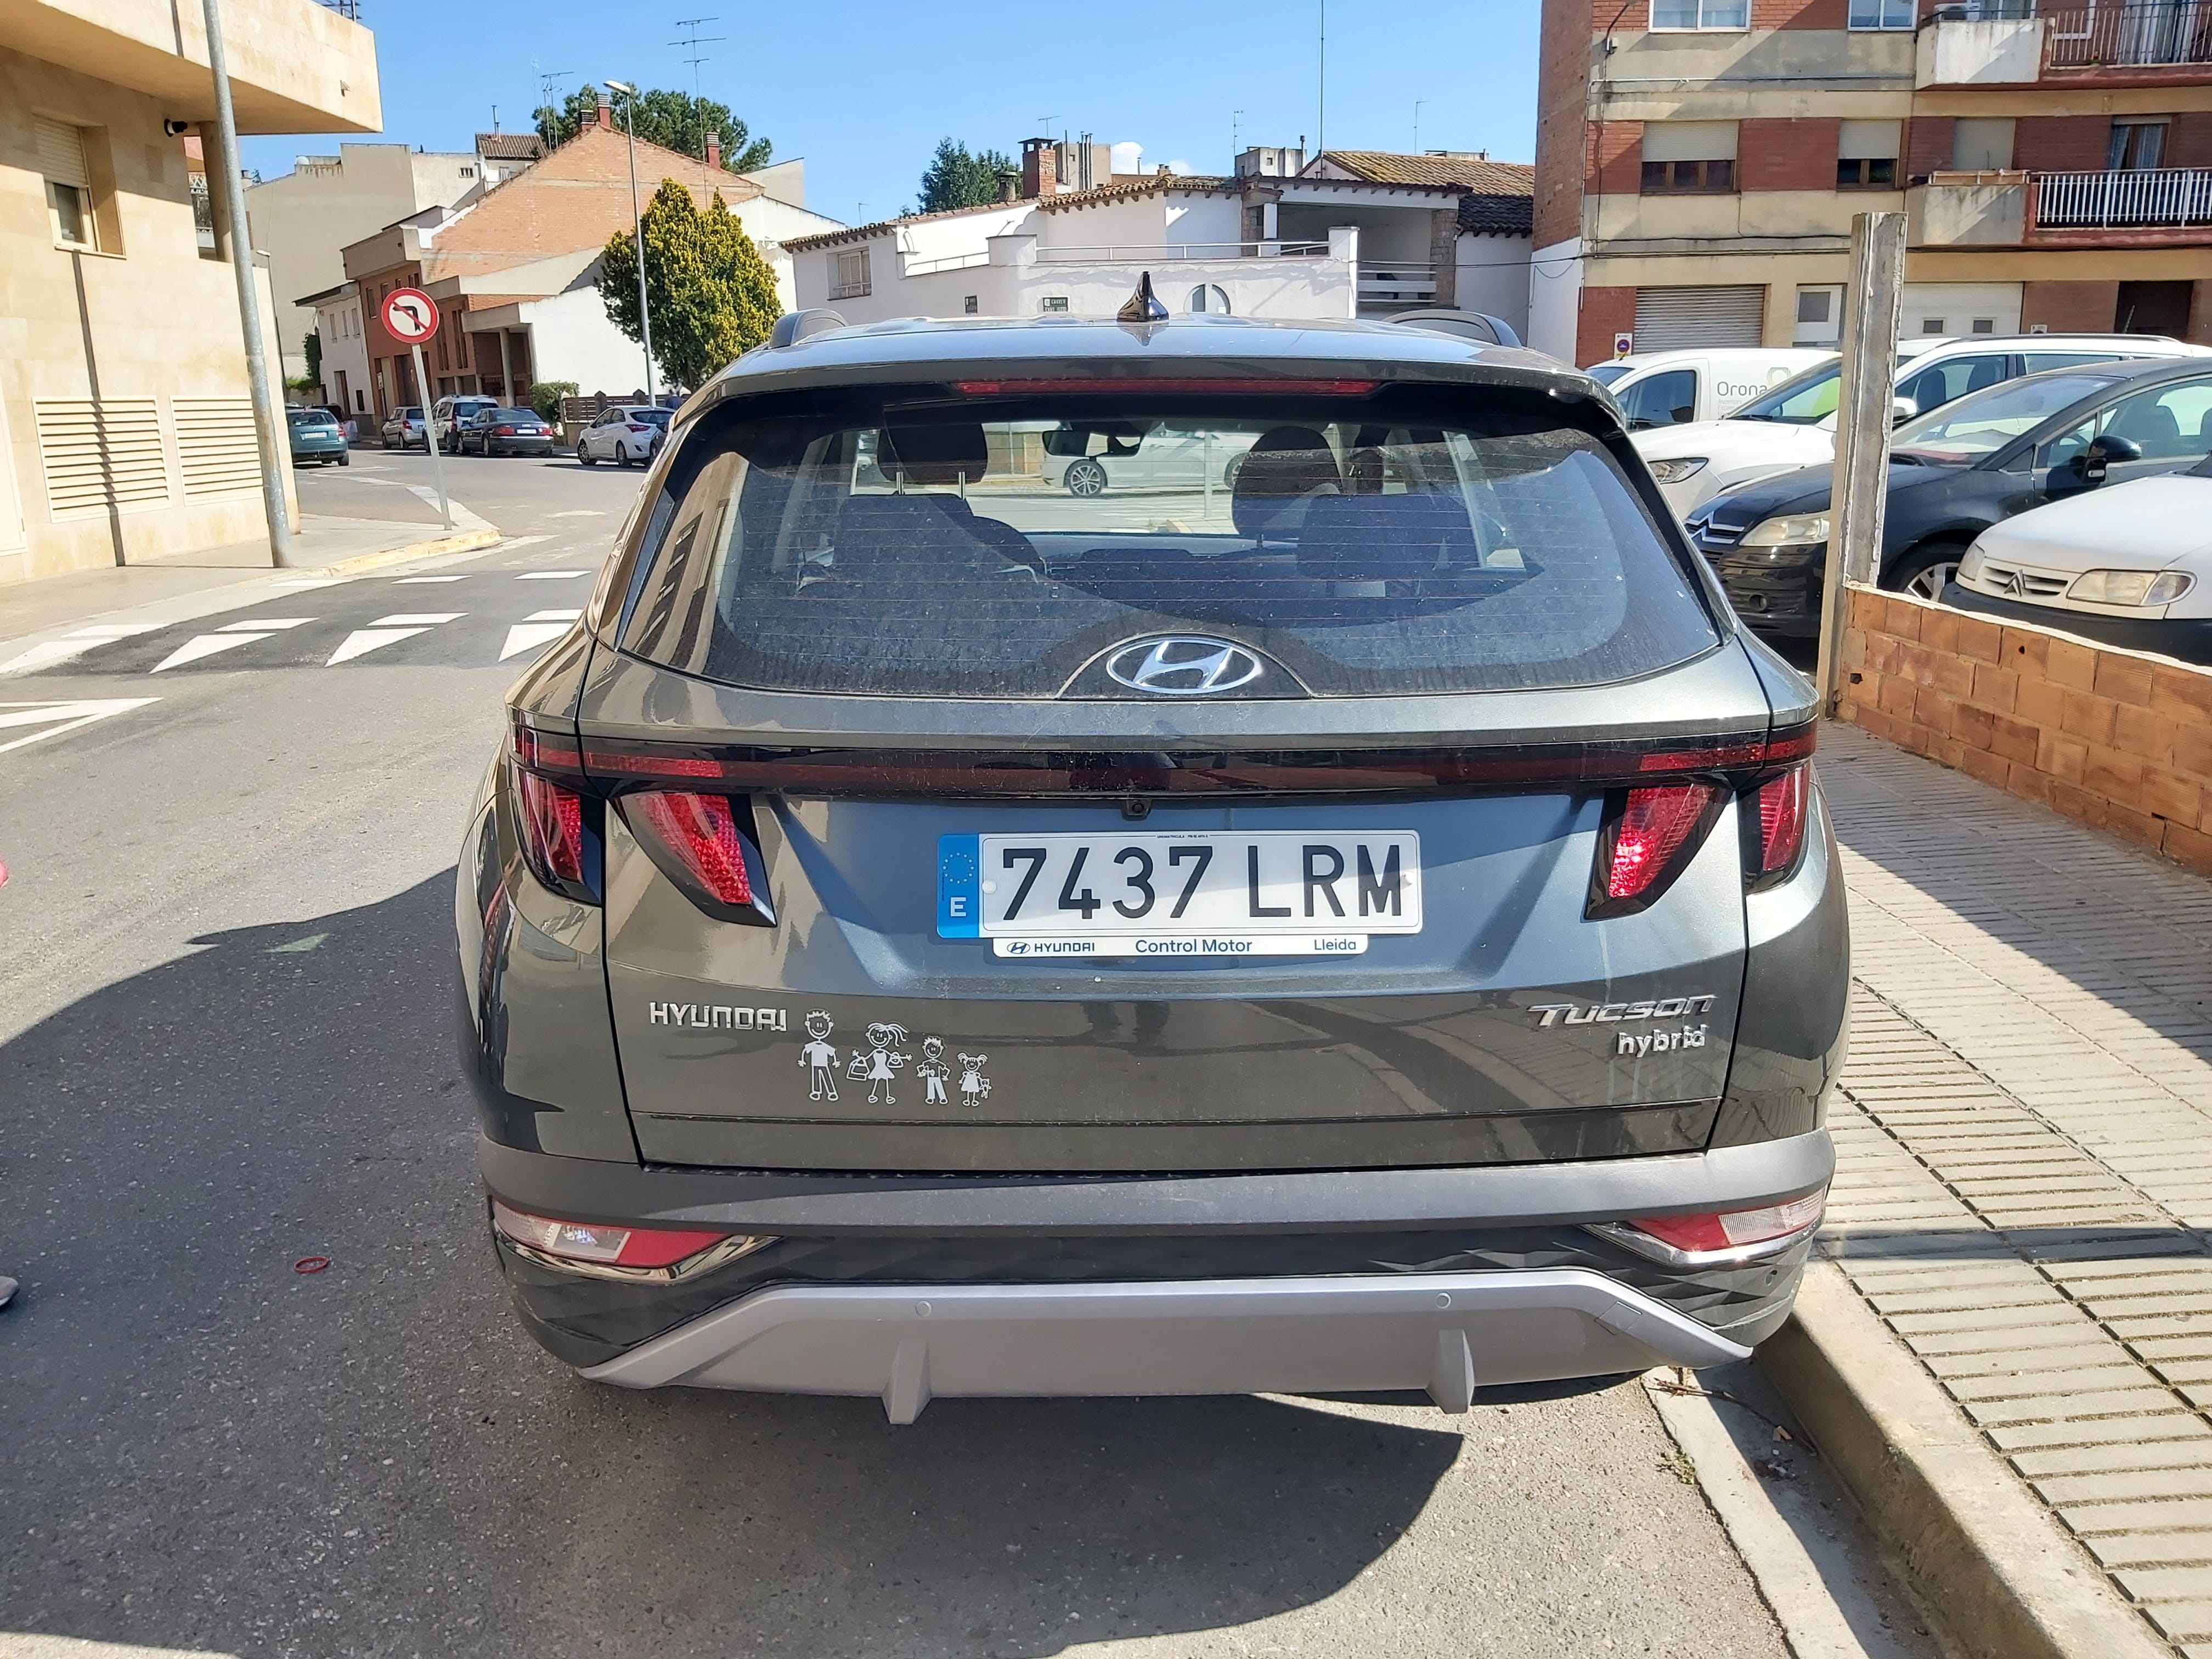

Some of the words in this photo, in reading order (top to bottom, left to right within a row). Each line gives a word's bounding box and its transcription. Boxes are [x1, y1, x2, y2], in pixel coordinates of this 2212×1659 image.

[1717, 381, 1767, 396] Orona
[1003, 845, 1213, 921] 7437
[1248, 844, 1402, 917] LRM
[950, 896, 967, 917] E
[1034, 942, 1095, 952] HYUNDAI
[1135, 939, 1197, 953] Control
[1202, 939, 1252, 952] Motor
[1314, 938, 1357, 950] Lleida
[649, 1002, 787, 1031] HYUNDAI
[1526, 994, 1718, 1026] TUCSON
[1617, 1024, 1709, 1058] hybrid
